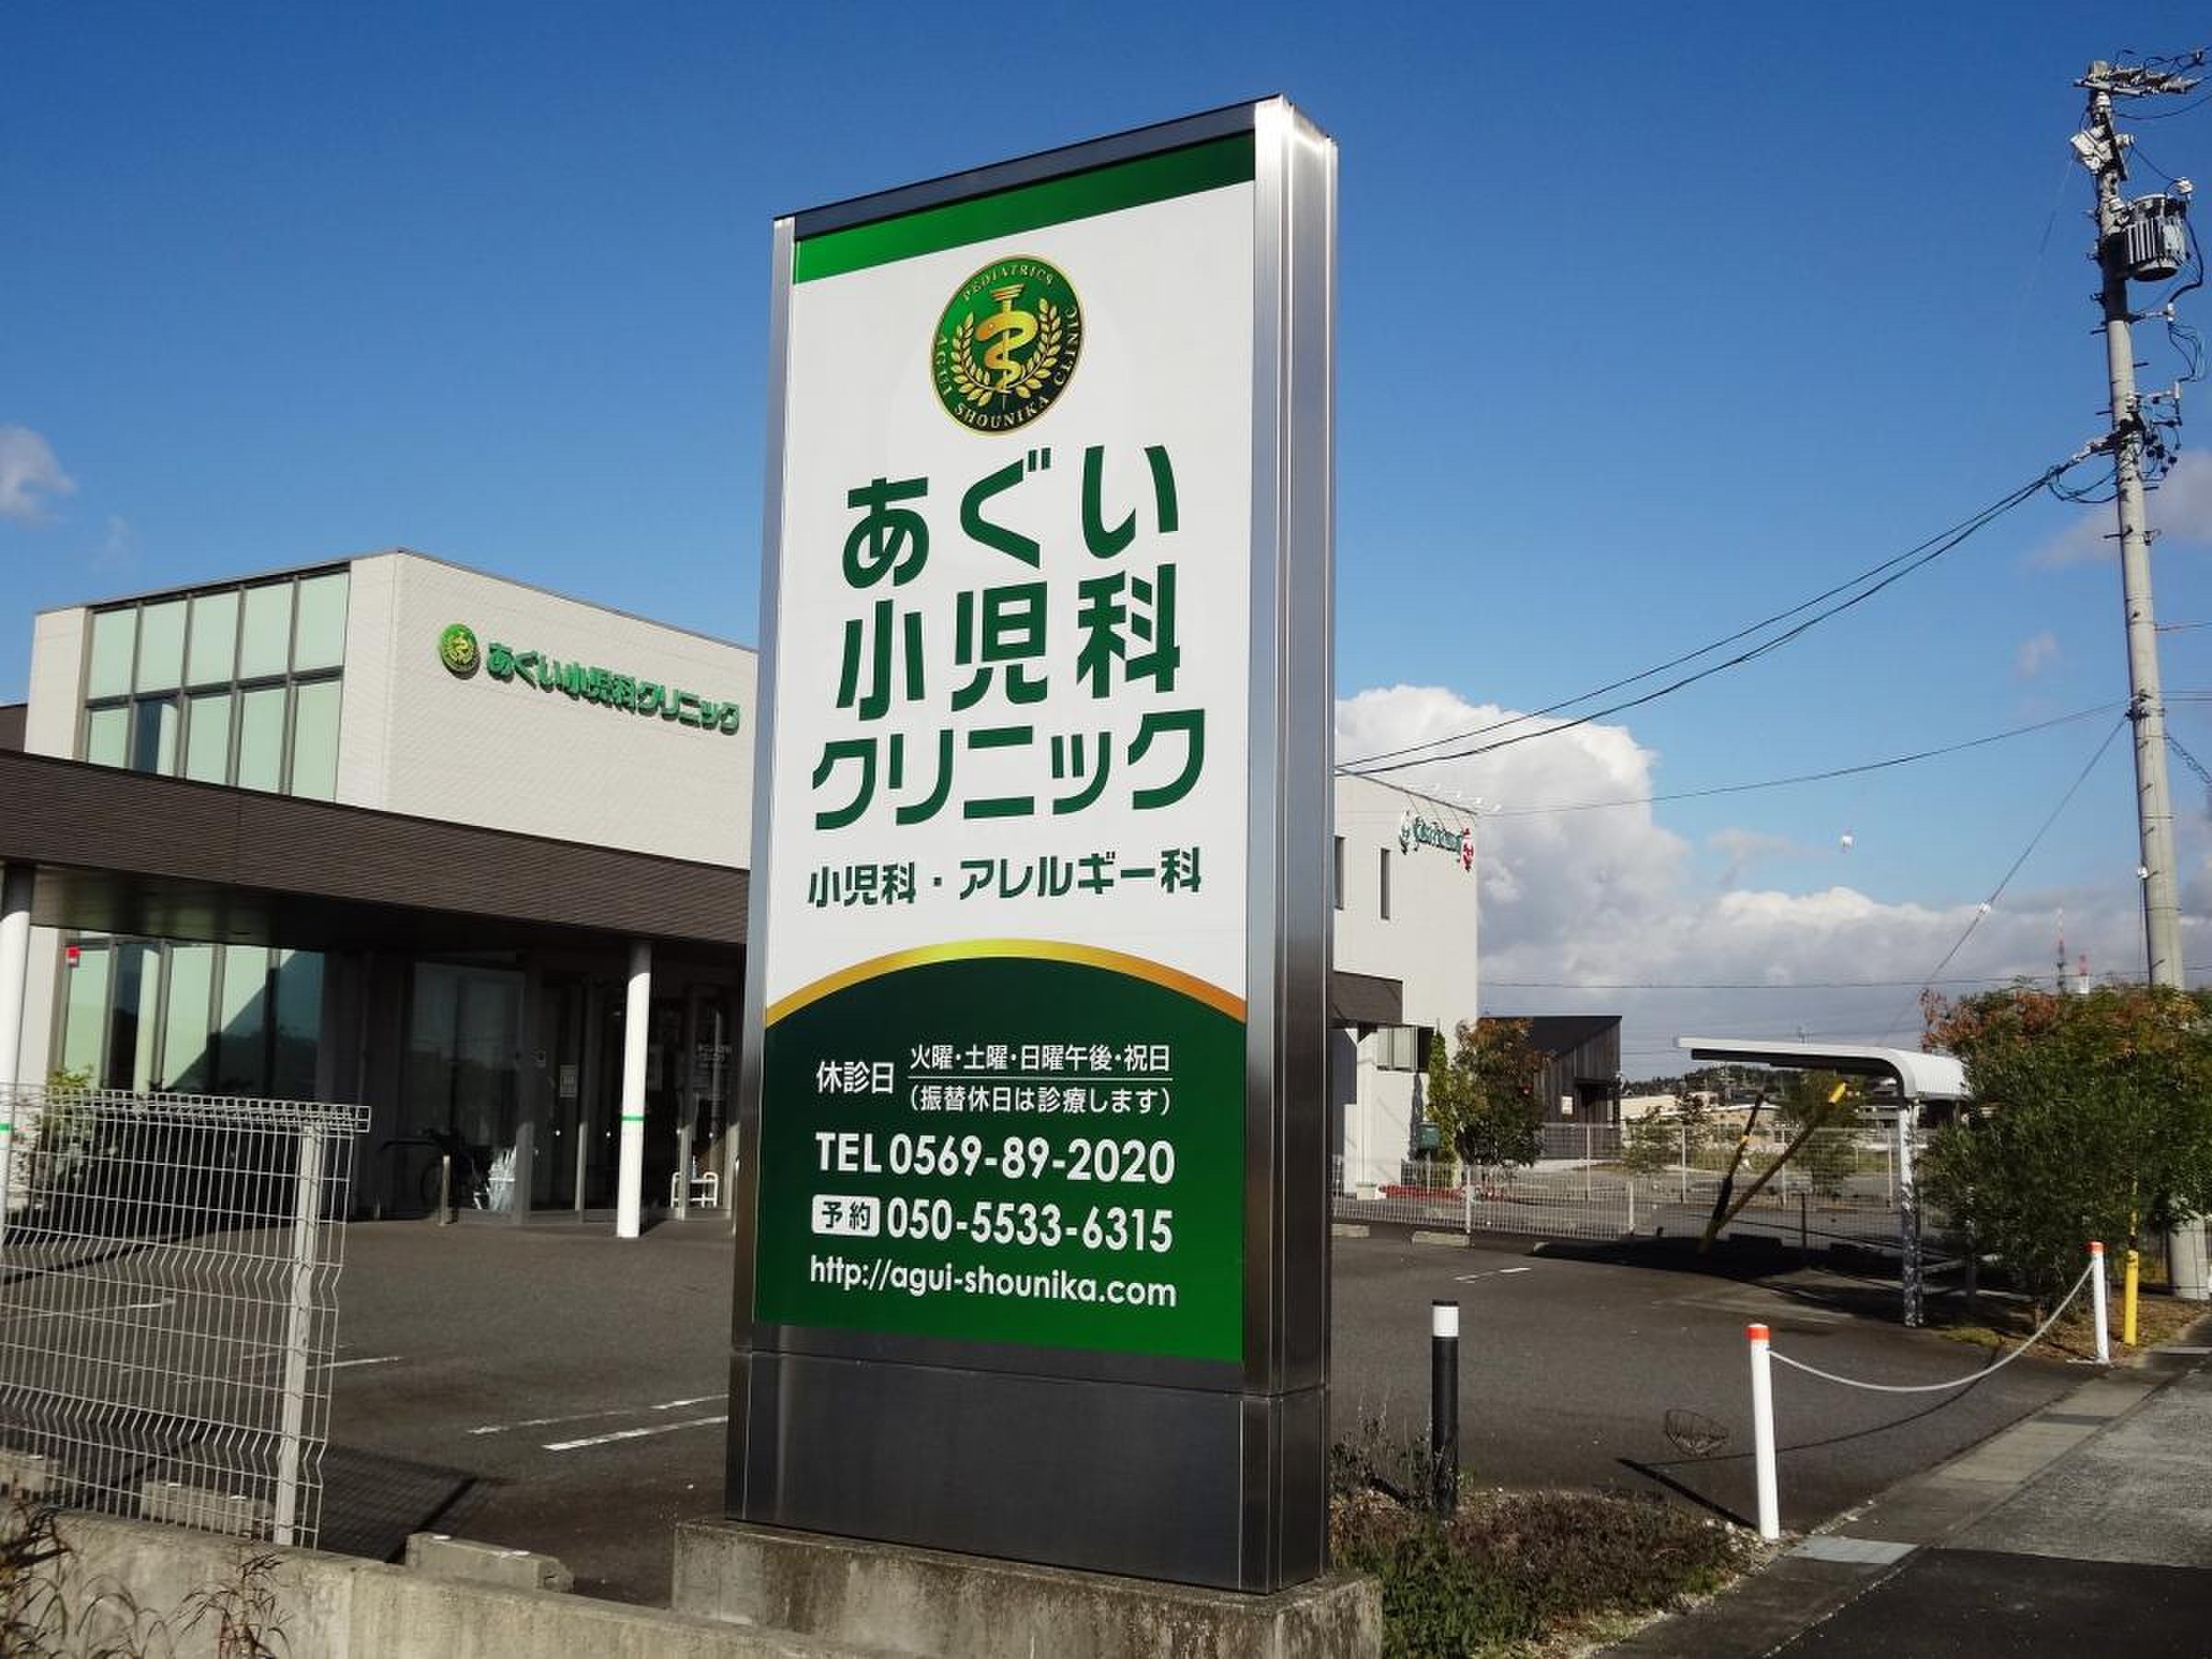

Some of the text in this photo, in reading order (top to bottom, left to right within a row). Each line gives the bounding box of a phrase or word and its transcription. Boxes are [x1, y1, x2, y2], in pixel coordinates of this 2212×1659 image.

[962, 264, 1053, 301] PEDIATRICS
[954, 394, 1051, 429] SHOUNIKA
[841, 443, 1180, 590] あぐい
[836, 562, 1181, 722] 小児科
[486, 641, 740, 735] あぐい小児科クリニック
[811, 708, 1206, 830] クリニック
[807, 846, 1202, 908] 小児科・アレルギー科
[816, 1060, 894, 1095] 休診日
[815, 1132, 1175, 1185] TEL 0569-89-2020
[821, 1197, 1174, 1253] 予約 050-5533-6315
[809, 1253, 1177, 1308] http://agui-shounika.com
